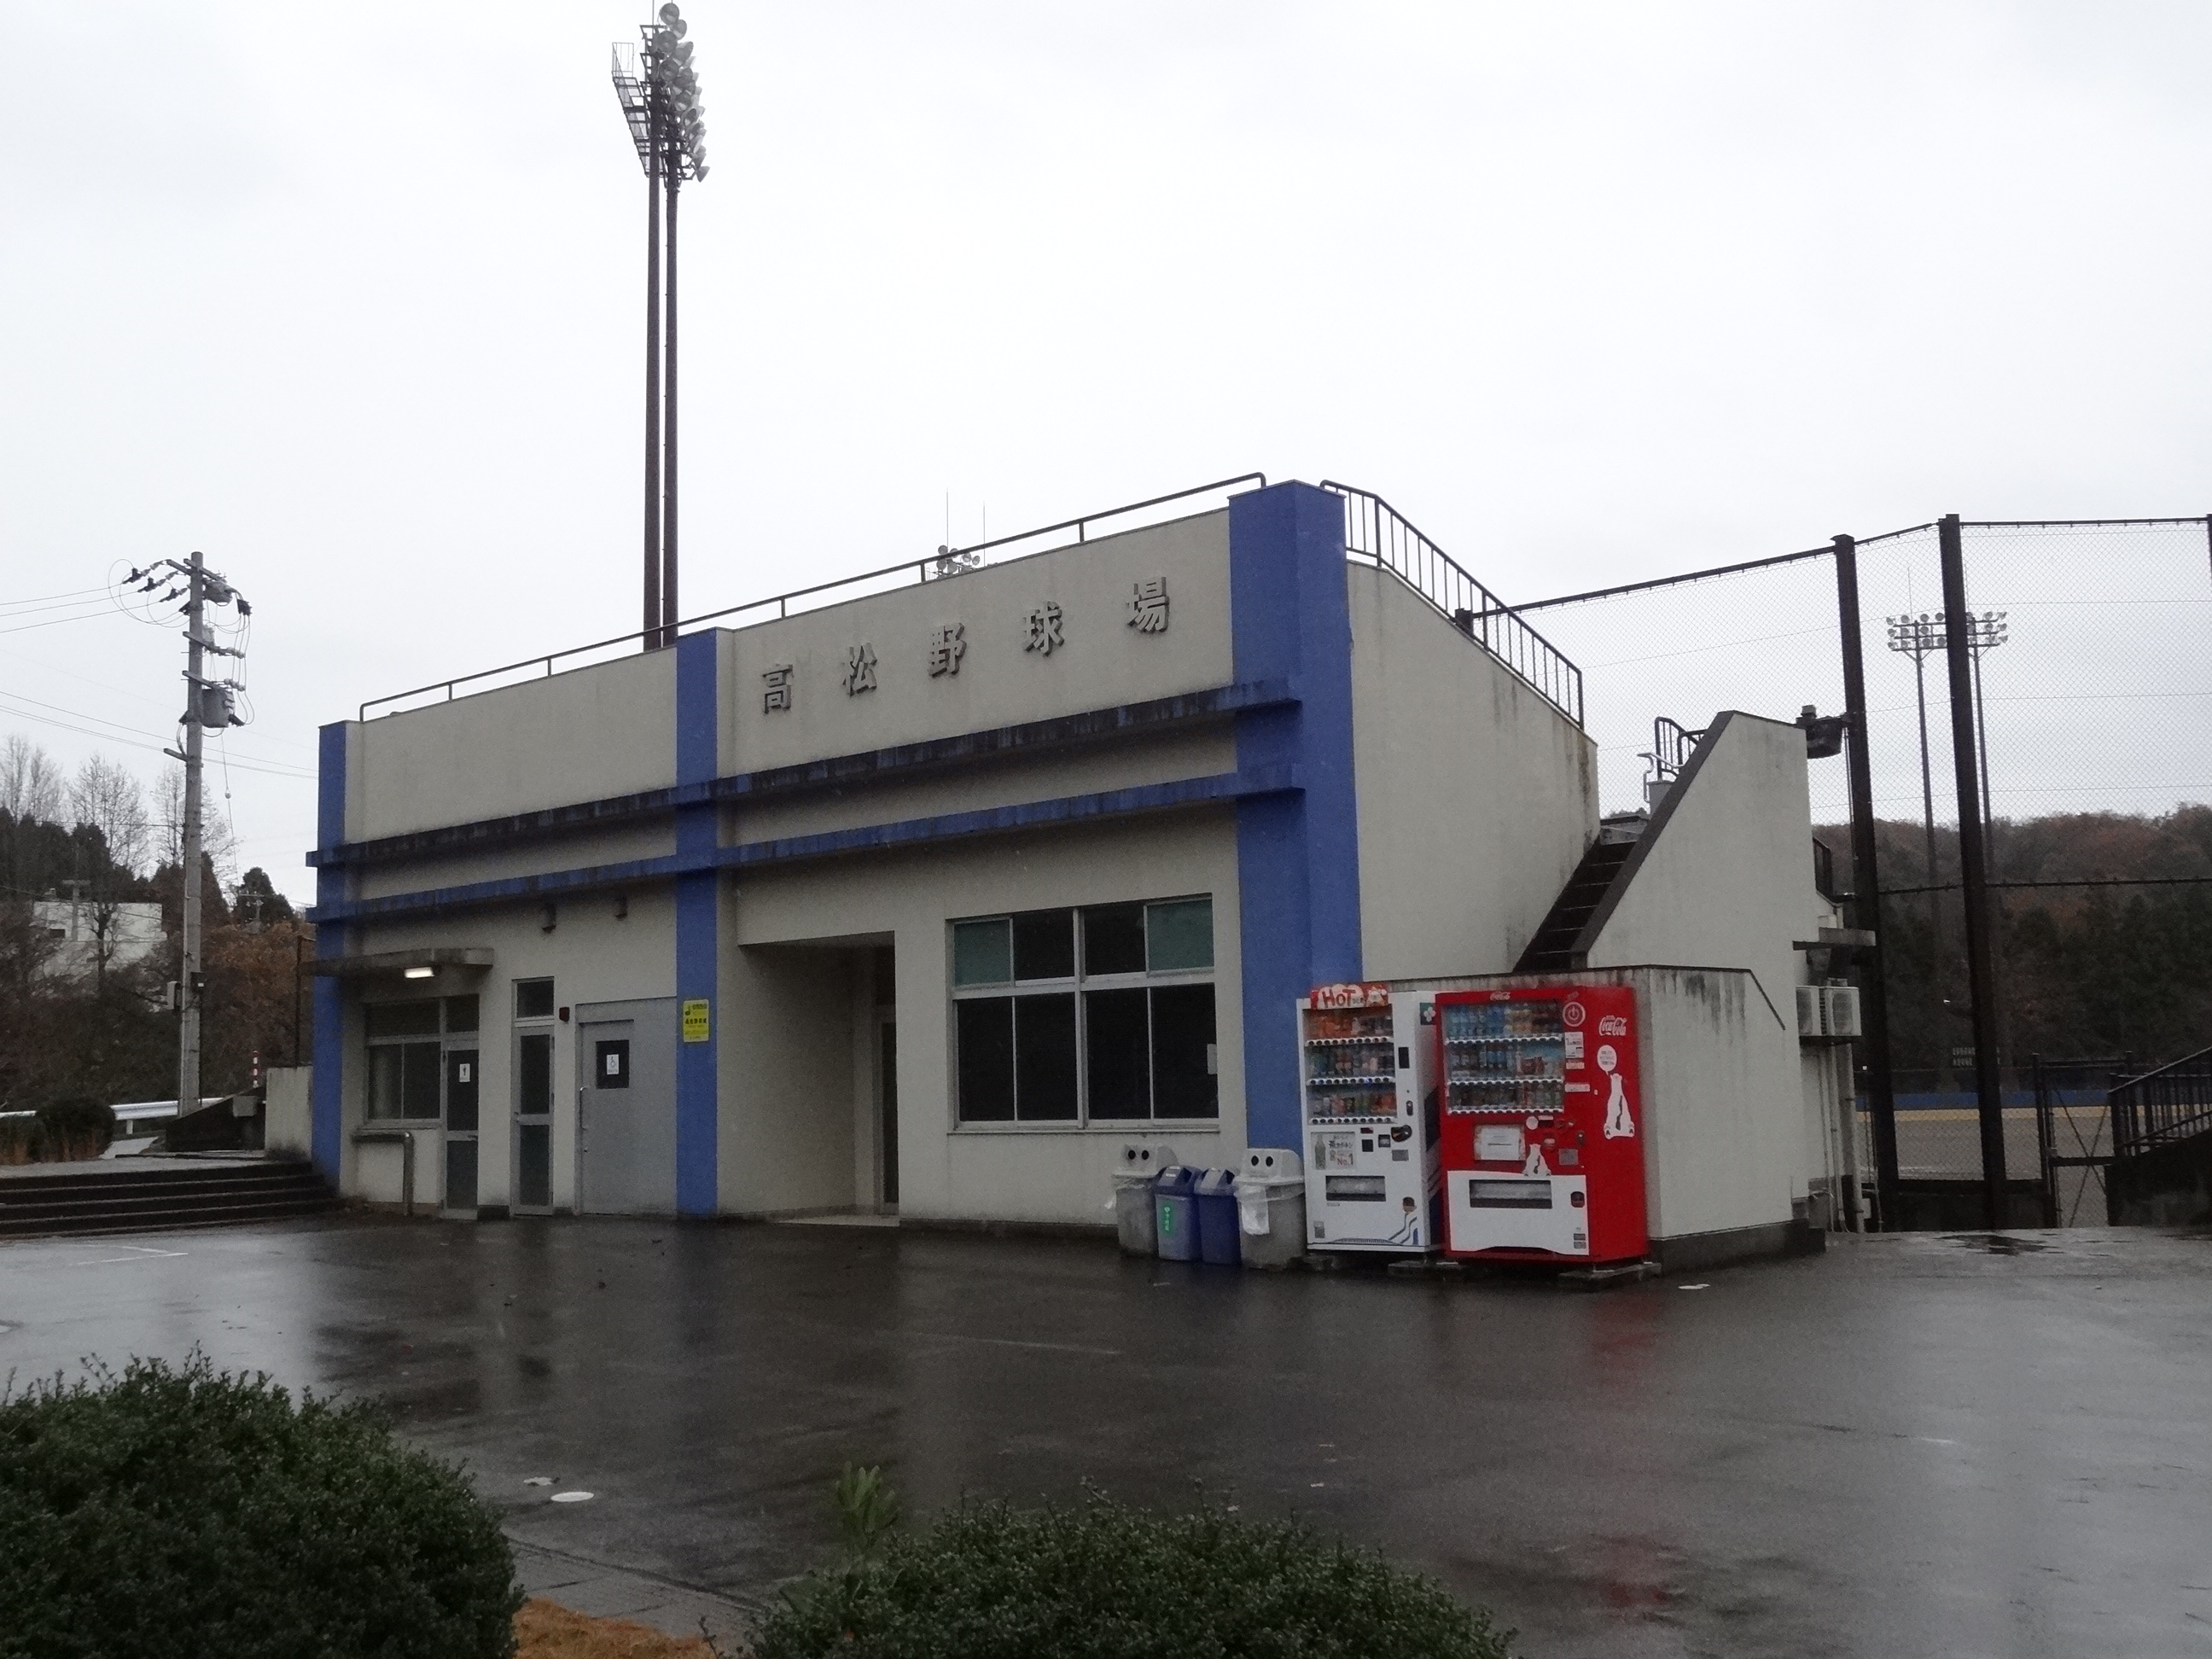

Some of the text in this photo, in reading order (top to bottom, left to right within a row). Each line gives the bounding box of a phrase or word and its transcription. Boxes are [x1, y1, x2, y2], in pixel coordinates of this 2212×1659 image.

[762, 576, 1171, 714] 高松野球場
